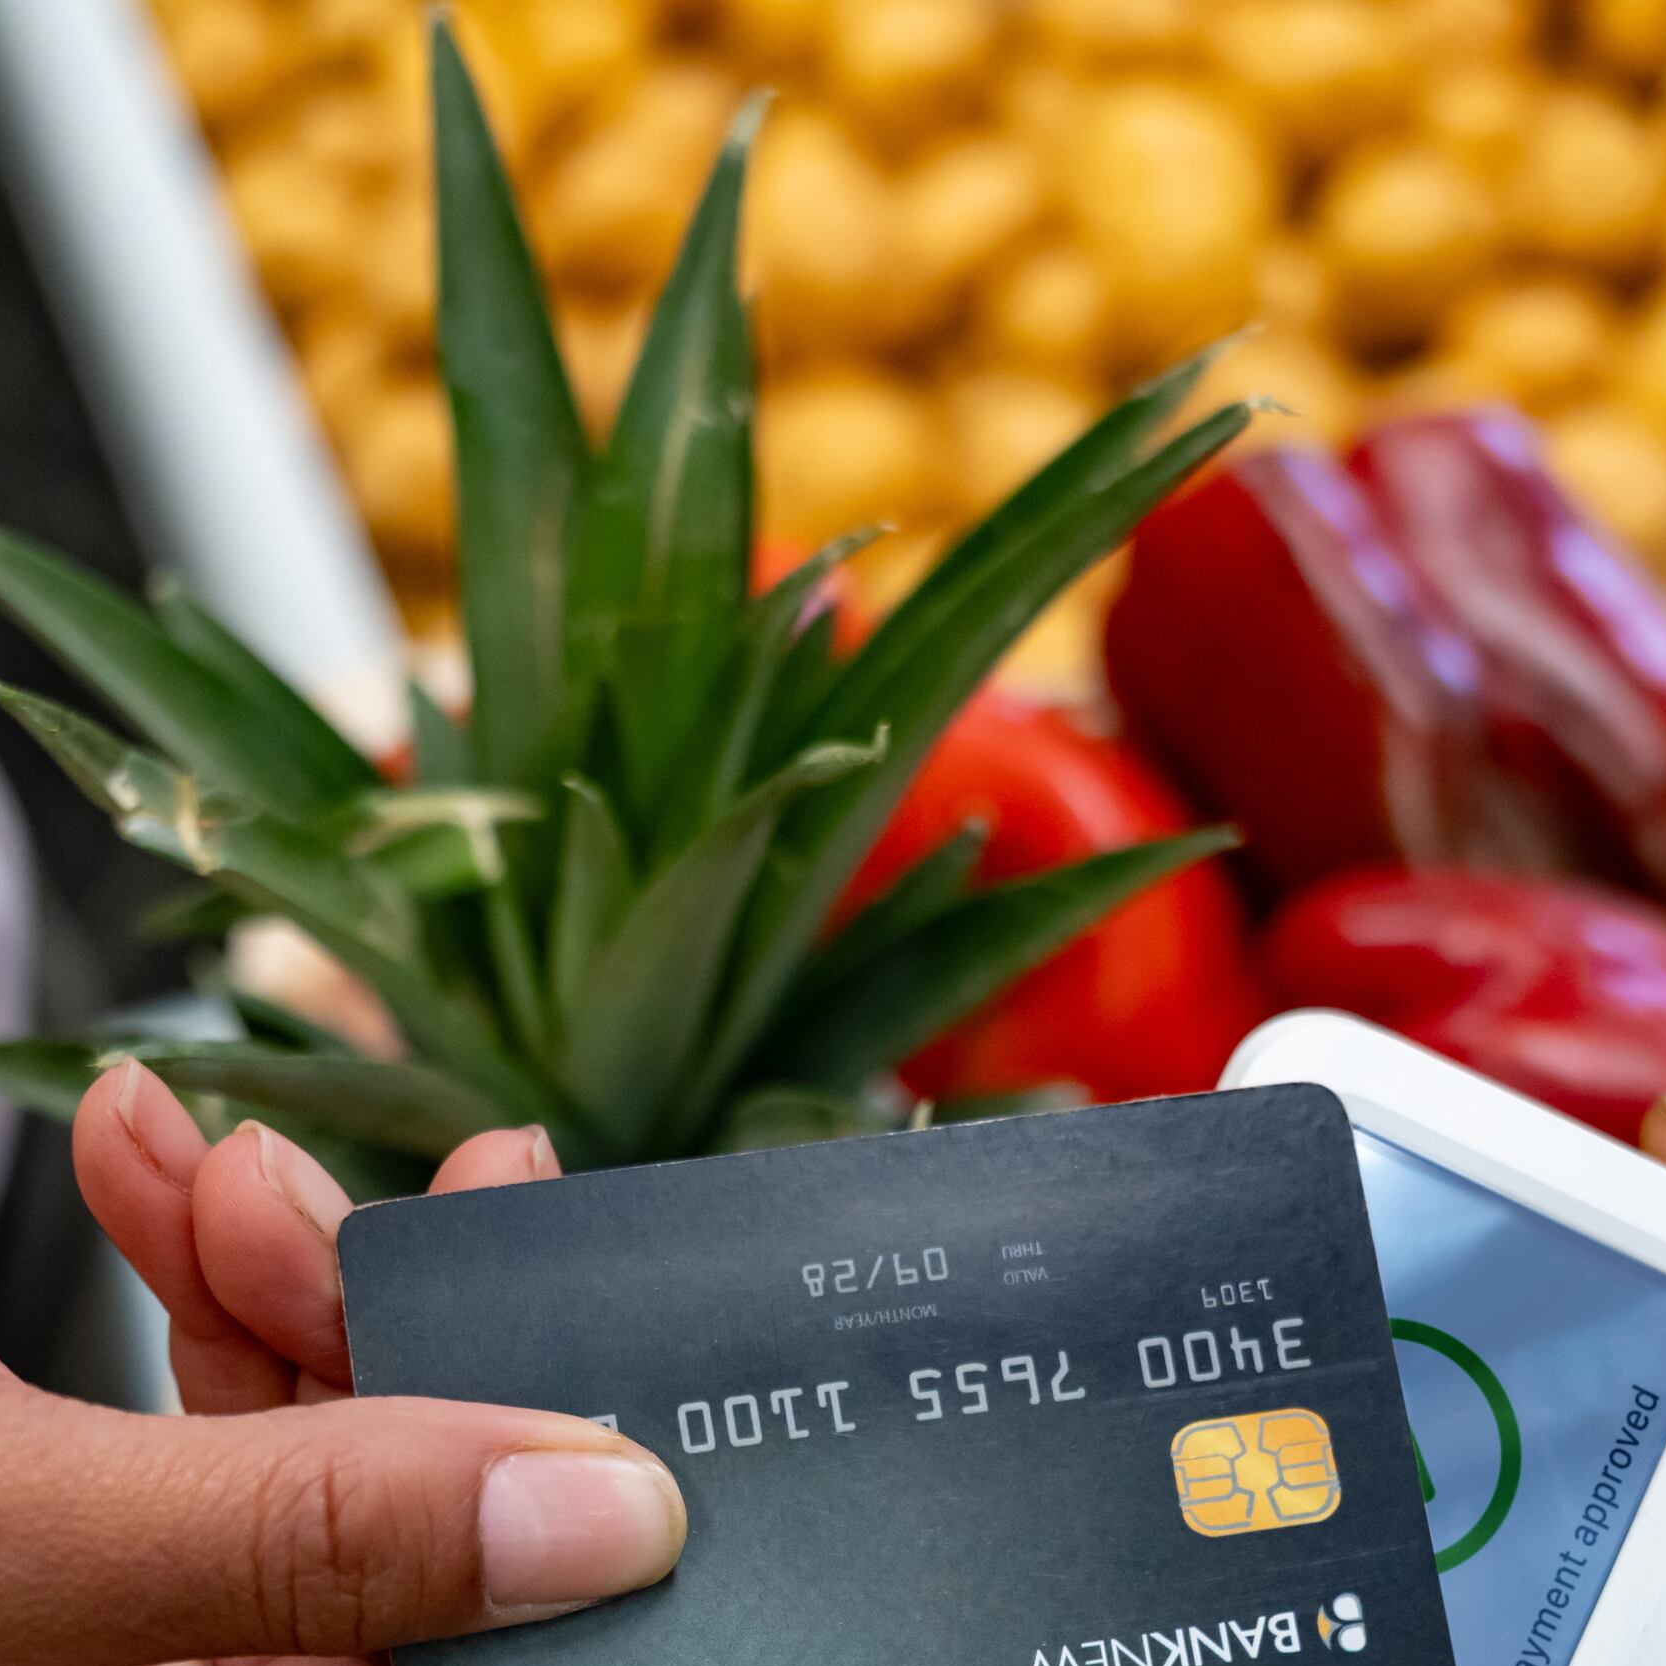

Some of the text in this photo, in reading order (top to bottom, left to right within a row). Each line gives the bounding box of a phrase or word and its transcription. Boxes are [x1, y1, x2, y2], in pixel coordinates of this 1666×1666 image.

[1001, 1240, 1044, 1260] THRU
[801, 1246, 949, 1298] 09/28
[1002, 1266, 1049, 1286] VALID
[1200, 1277, 1274, 1309] 1309
[833, 1303, 938, 1331] MONTH/YEAR
[677, 1316, 1312, 1455] 3400 7655 1100
[1573, 1383, 1661, 1548] approved
